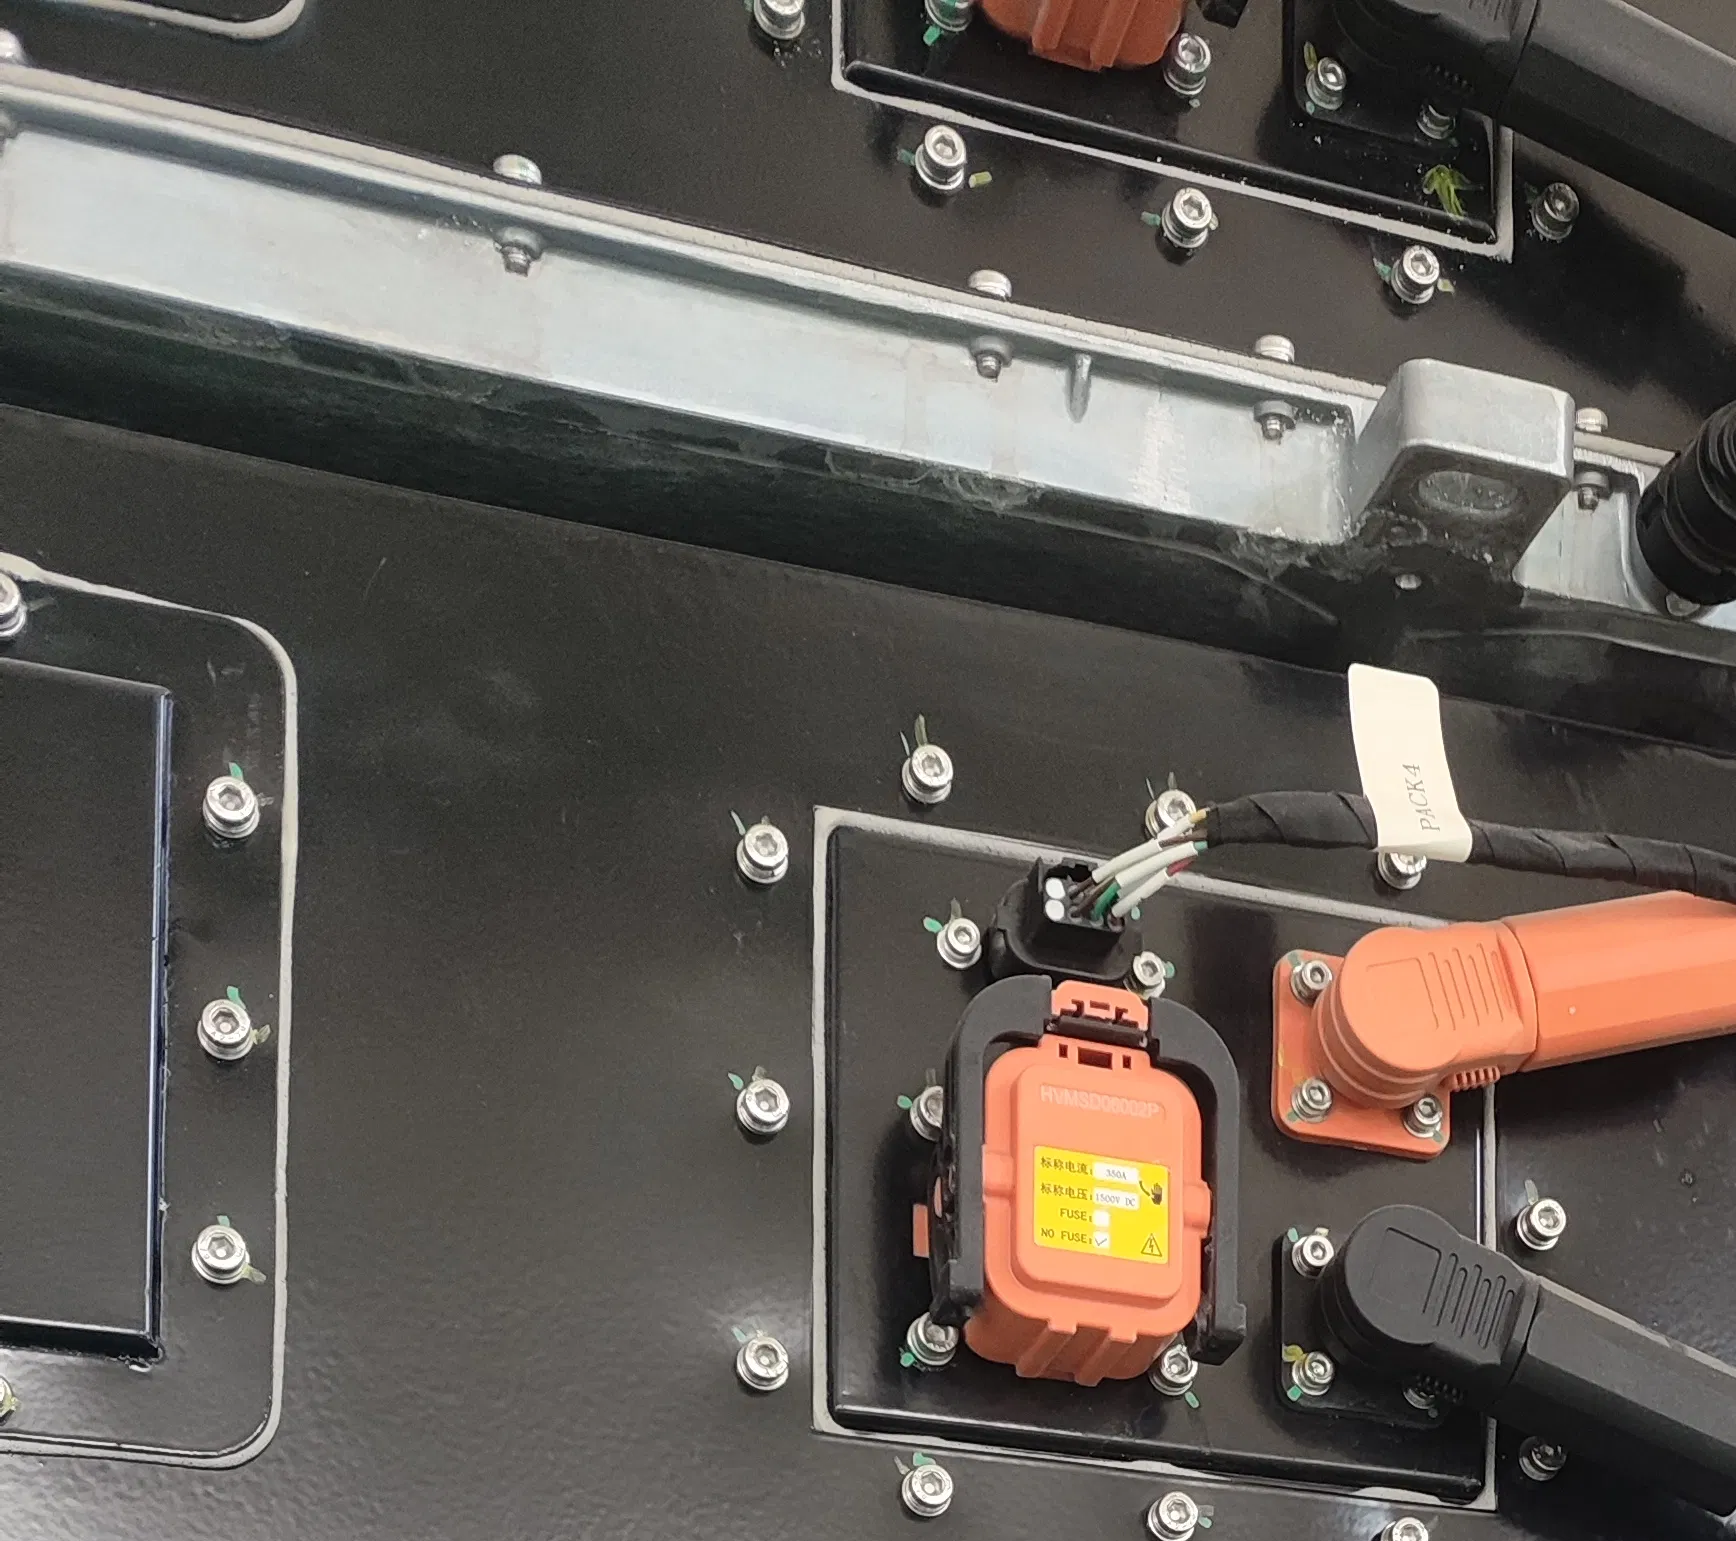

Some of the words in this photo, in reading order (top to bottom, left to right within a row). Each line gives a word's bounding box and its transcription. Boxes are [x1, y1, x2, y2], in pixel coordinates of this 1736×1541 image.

[1402, 763, 1440, 832] PACK4
[1125, 1196, 1136, 1207] DC
[1041, 1227, 1055, 1239] NO
